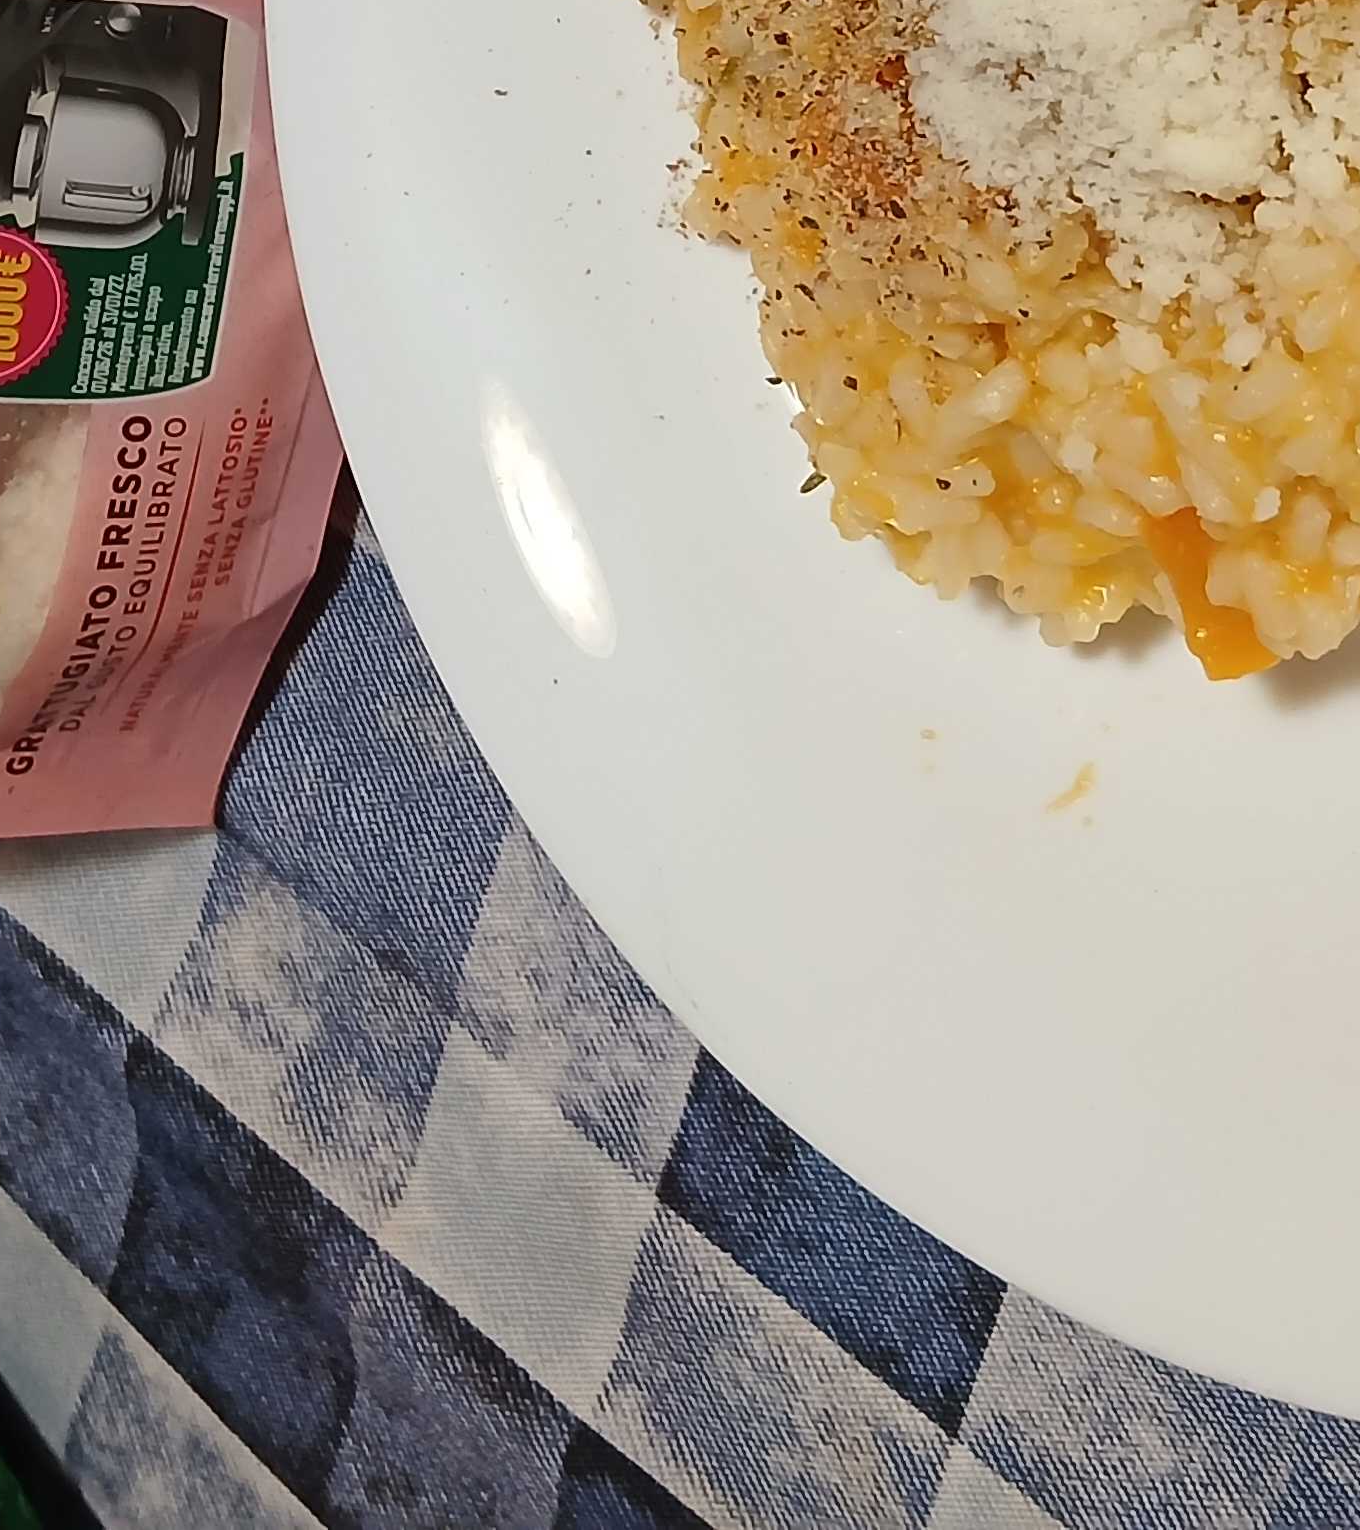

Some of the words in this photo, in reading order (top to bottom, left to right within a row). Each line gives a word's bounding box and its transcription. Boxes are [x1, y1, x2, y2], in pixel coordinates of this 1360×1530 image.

[5, 584, 118, 776] GRATTUGIATO
[96, 415, 153, 571] FRESCO
[59, 693, 97, 733] DAL
[123, 416, 188, 615] EQUILIBRATO
[187, 532, 220, 604] SENZA
[214, 516, 247, 586] SENZA
